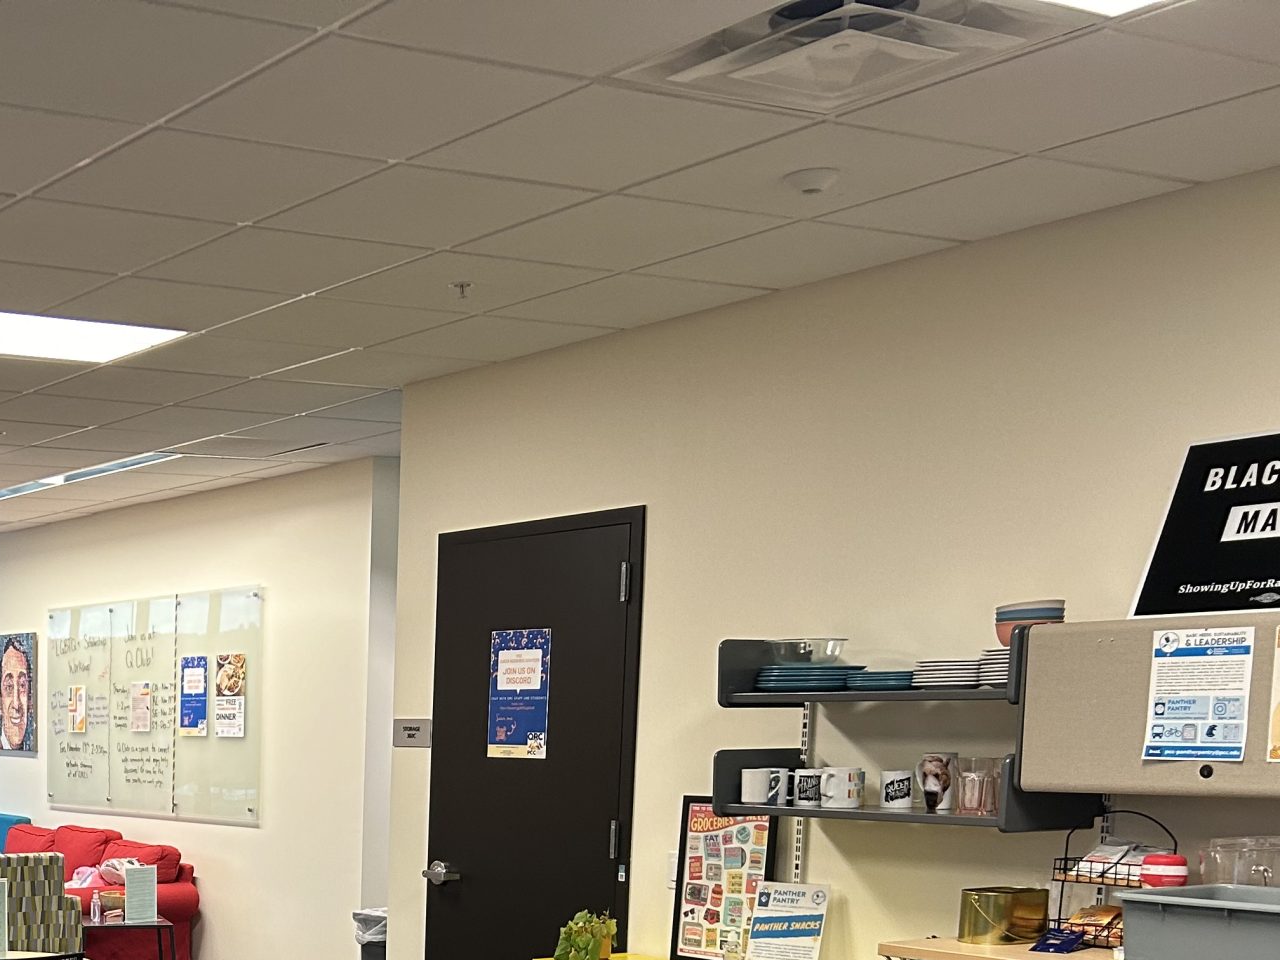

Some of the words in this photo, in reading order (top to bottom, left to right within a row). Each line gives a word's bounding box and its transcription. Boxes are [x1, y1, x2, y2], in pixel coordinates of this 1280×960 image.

[1185, 639, 1192, 647] &
[1194, 637, 1247, 646] LEADERSHIP
[125, 650, 134, 668] Q
[135, 647, 154, 668] Club!
[503, 667, 517, 675] JOIN
[506, 677, 532, 685] DISCORD
[216, 713, 237, 721] DINNER
[527, 733, 544, 741] QRC
[691, 815, 734, 832] GROCERIES
[773, 889, 807, 898] PANTHER
[772, 897, 800, 905] PANTRY
[753, 922, 789, 932] PANTHER
[789, 920, 822, 930] SNACKS
